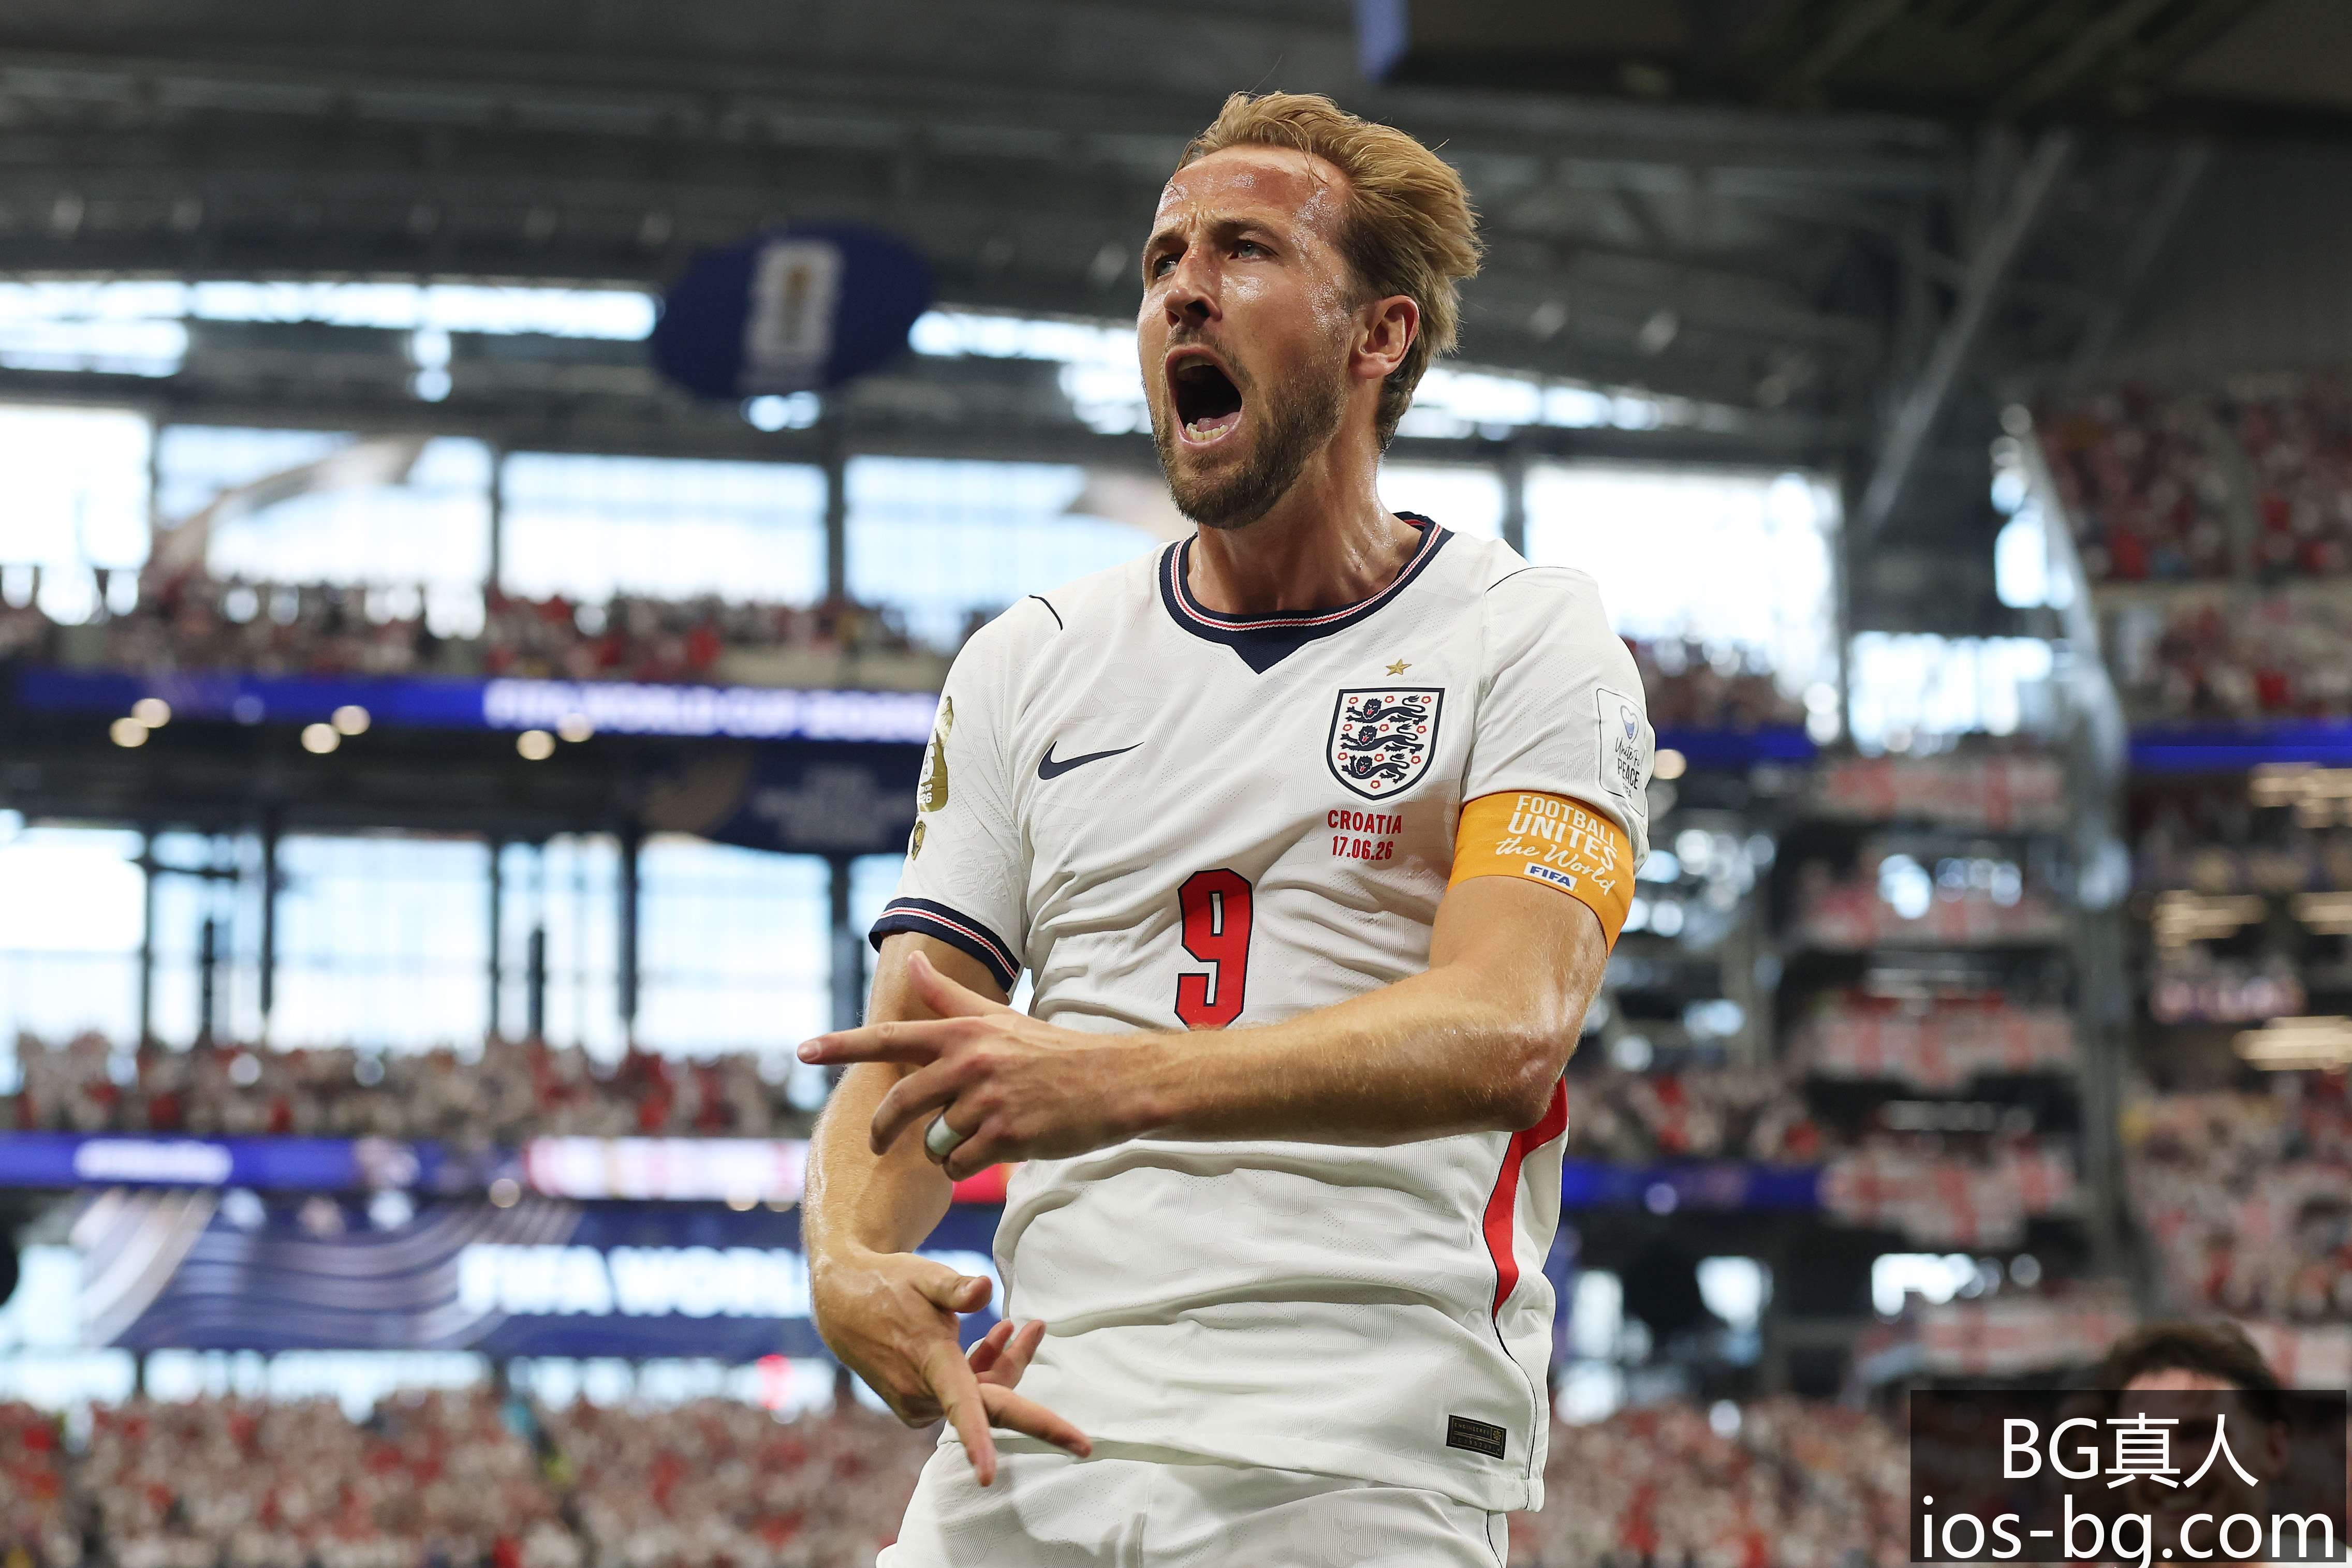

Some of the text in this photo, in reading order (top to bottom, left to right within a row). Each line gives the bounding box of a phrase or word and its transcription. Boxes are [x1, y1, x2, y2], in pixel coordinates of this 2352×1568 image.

[1615, 737, 1634, 760] Unite
[1618, 757, 1640, 790] PEACE
[1327, 809, 1402, 834] CROATIA
[1508, 811, 1617, 871] UNITES
[1516, 794, 1618, 853] FOOTBALL
[1332, 835, 1393, 860] 17.06.26
[1495, 836, 1616, 896] the World
[1530, 866, 1571, 887] FIFA
[1174, 867, 1254, 1031] 9
[611, 1246, 811, 1318] WORL
